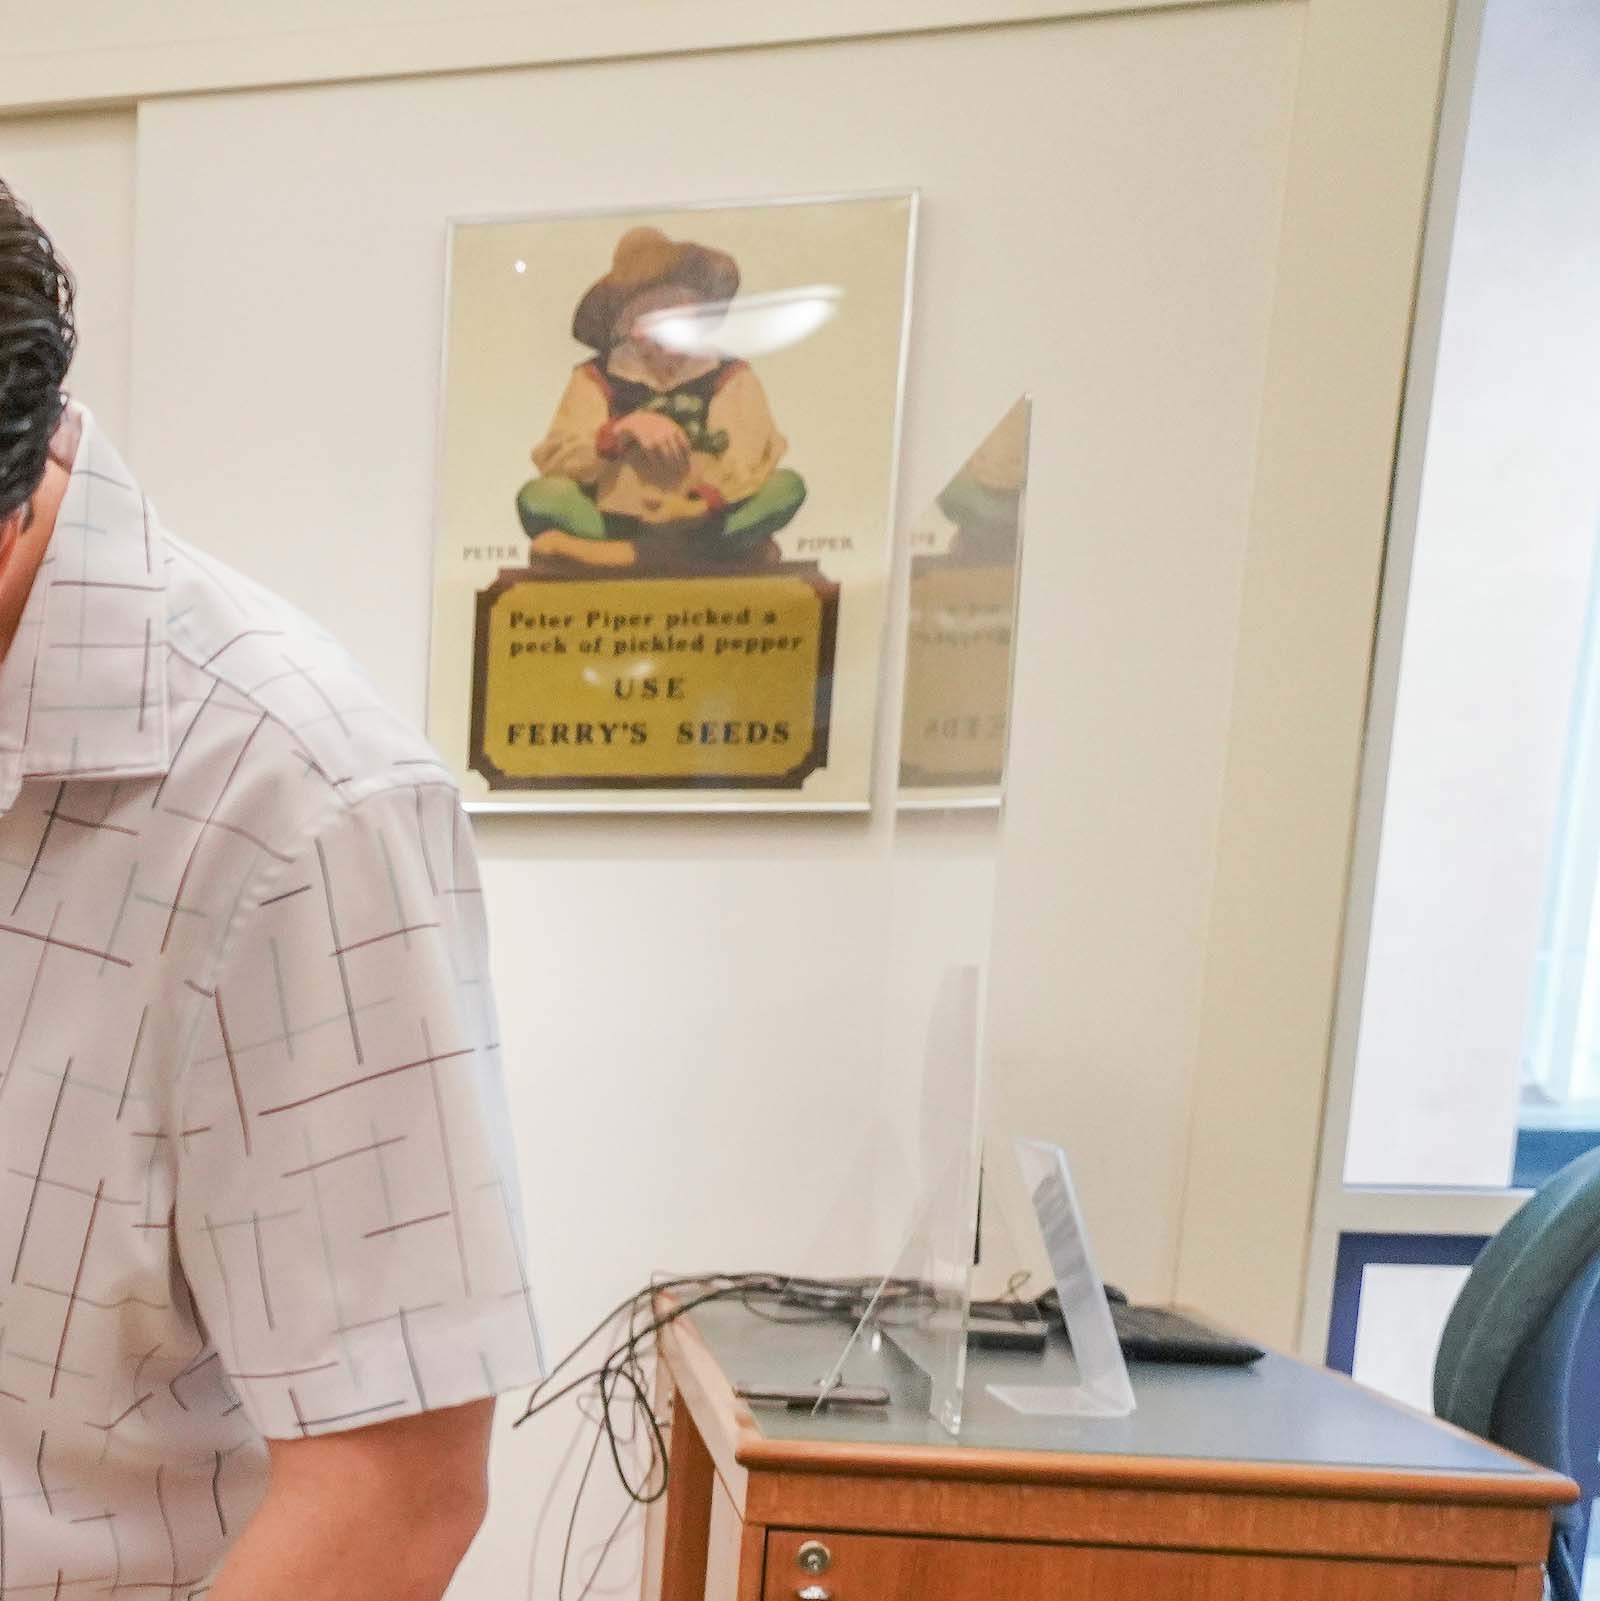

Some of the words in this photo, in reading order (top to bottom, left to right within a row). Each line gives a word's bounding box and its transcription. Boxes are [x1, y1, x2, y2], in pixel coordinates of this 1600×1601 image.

[509, 611, 573, 629] Peter
[587, 610, 655, 630] Piper
[666, 607, 750, 629] picked
[762, 612, 778, 625] a
[510, 636, 567, 656] peck
[579, 636, 603, 654] of
[613, 632, 705, 656] pickled
[715, 634, 801, 655] pepper
[613, 677, 685, 699] USE
[507, 722, 648, 746] FERRY'S
[676, 720, 790, 745] SEEDS
